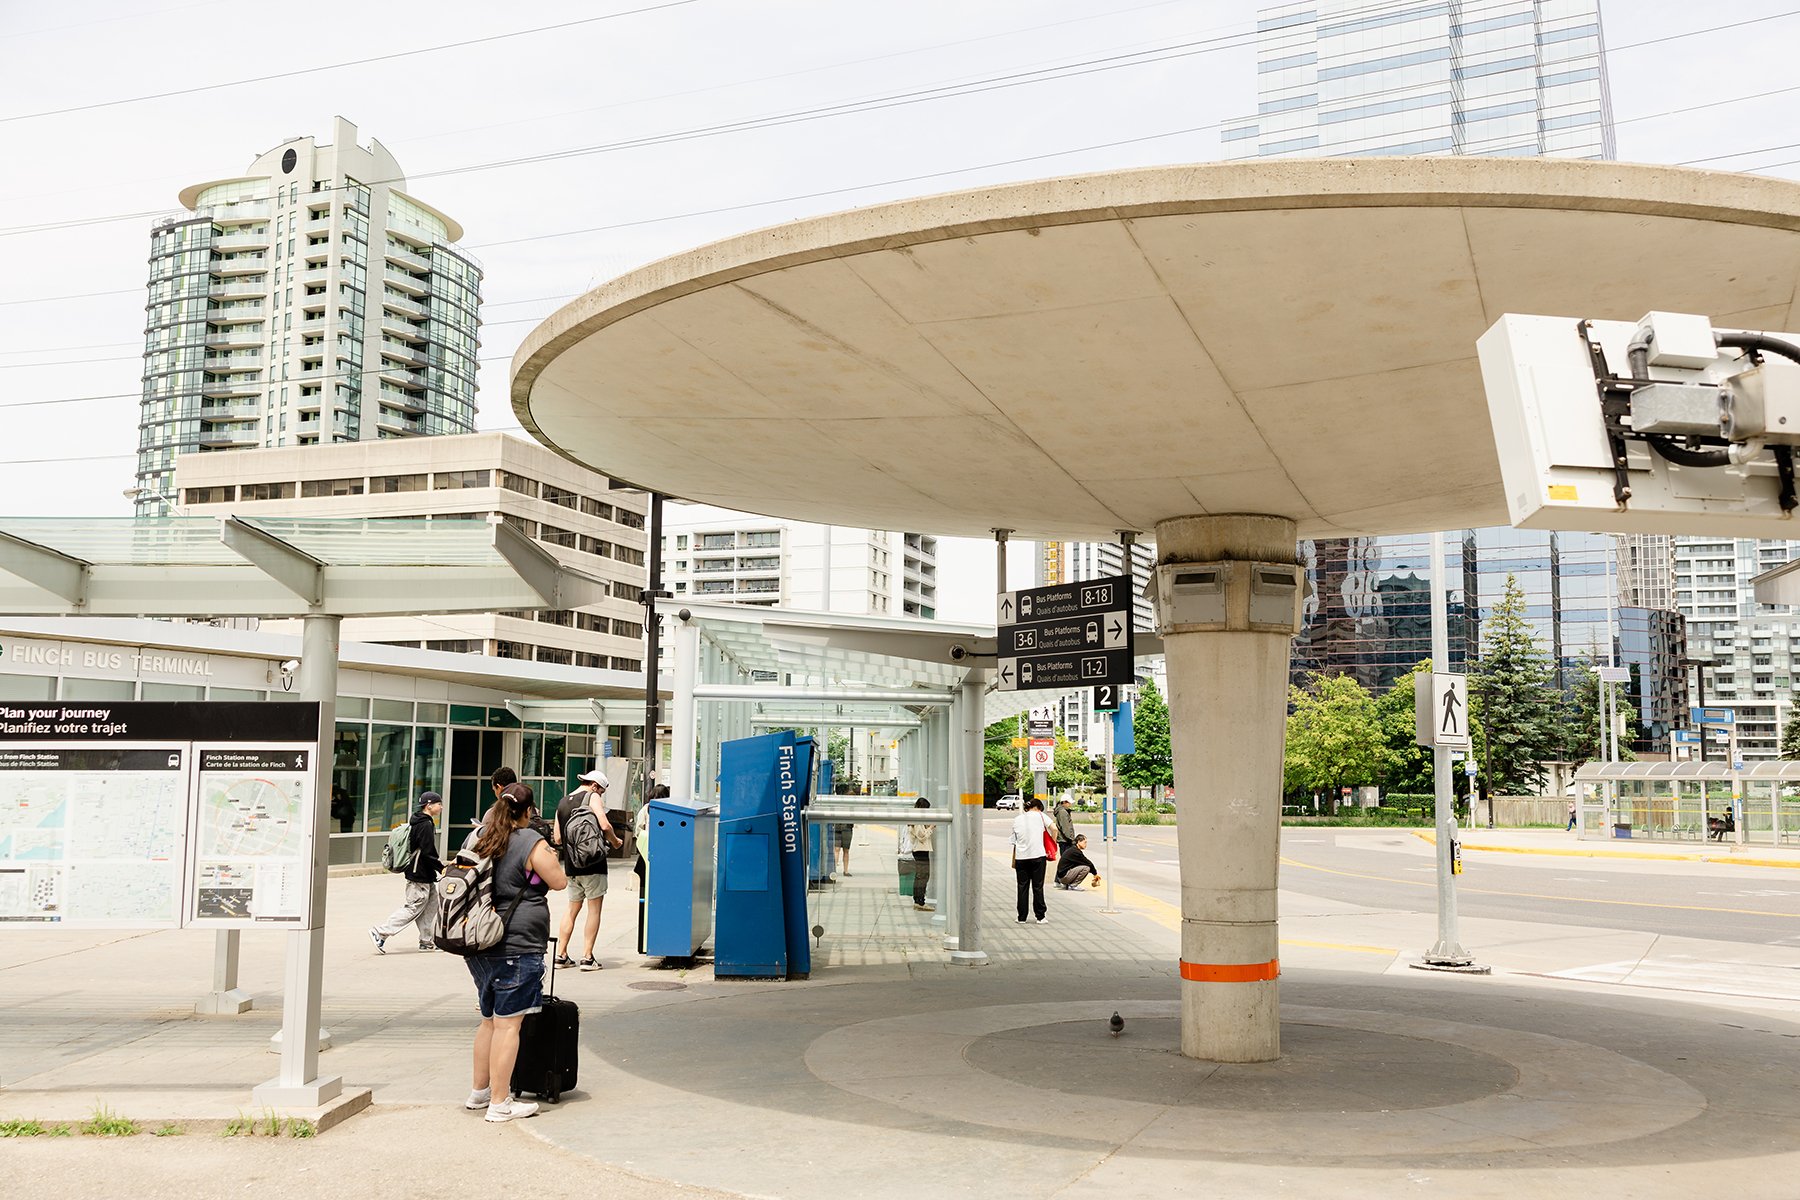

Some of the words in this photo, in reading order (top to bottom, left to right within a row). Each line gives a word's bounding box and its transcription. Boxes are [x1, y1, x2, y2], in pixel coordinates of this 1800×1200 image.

[1036, 595, 1046, 603] Bus
[1046, 592, 1072, 602] Platforms
[1085, 588, 1108, 604] 8-18
[1036, 607, 1051, 616] Quais
[1052, 604, 1078, 613] d'autobus
[1044, 628, 1054, 636] Bus
[1054, 626, 1080, 636] Platforms
[1018, 633, 1033, 646] 3-6
[1039, 640, 1054, 648] Quais
[1054, 638, 1080, 648] d'autobus
[12, 645, 73, 666] FINCH
[83, 651, 122, 669] BUS
[130, 654, 214, 676] TERMINAL
[1036, 663, 1046, 672] Bus
[1047, 661, 1073, 670] Platforms
[1086, 660, 1103, 676] 1-2
[1036, 675, 1051, 683] Quais
[1052, 673, 1078, 682] d'autobus
[1100, 685, 1112, 705] 2
[28, 709, 58, 721] your
[60, 707, 110, 721] journey
[54, 723, 88, 734] votre
[92, 722, 128, 736] trajet
[779, 745, 795, 790] Finch
[782, 794, 798, 852] Station
